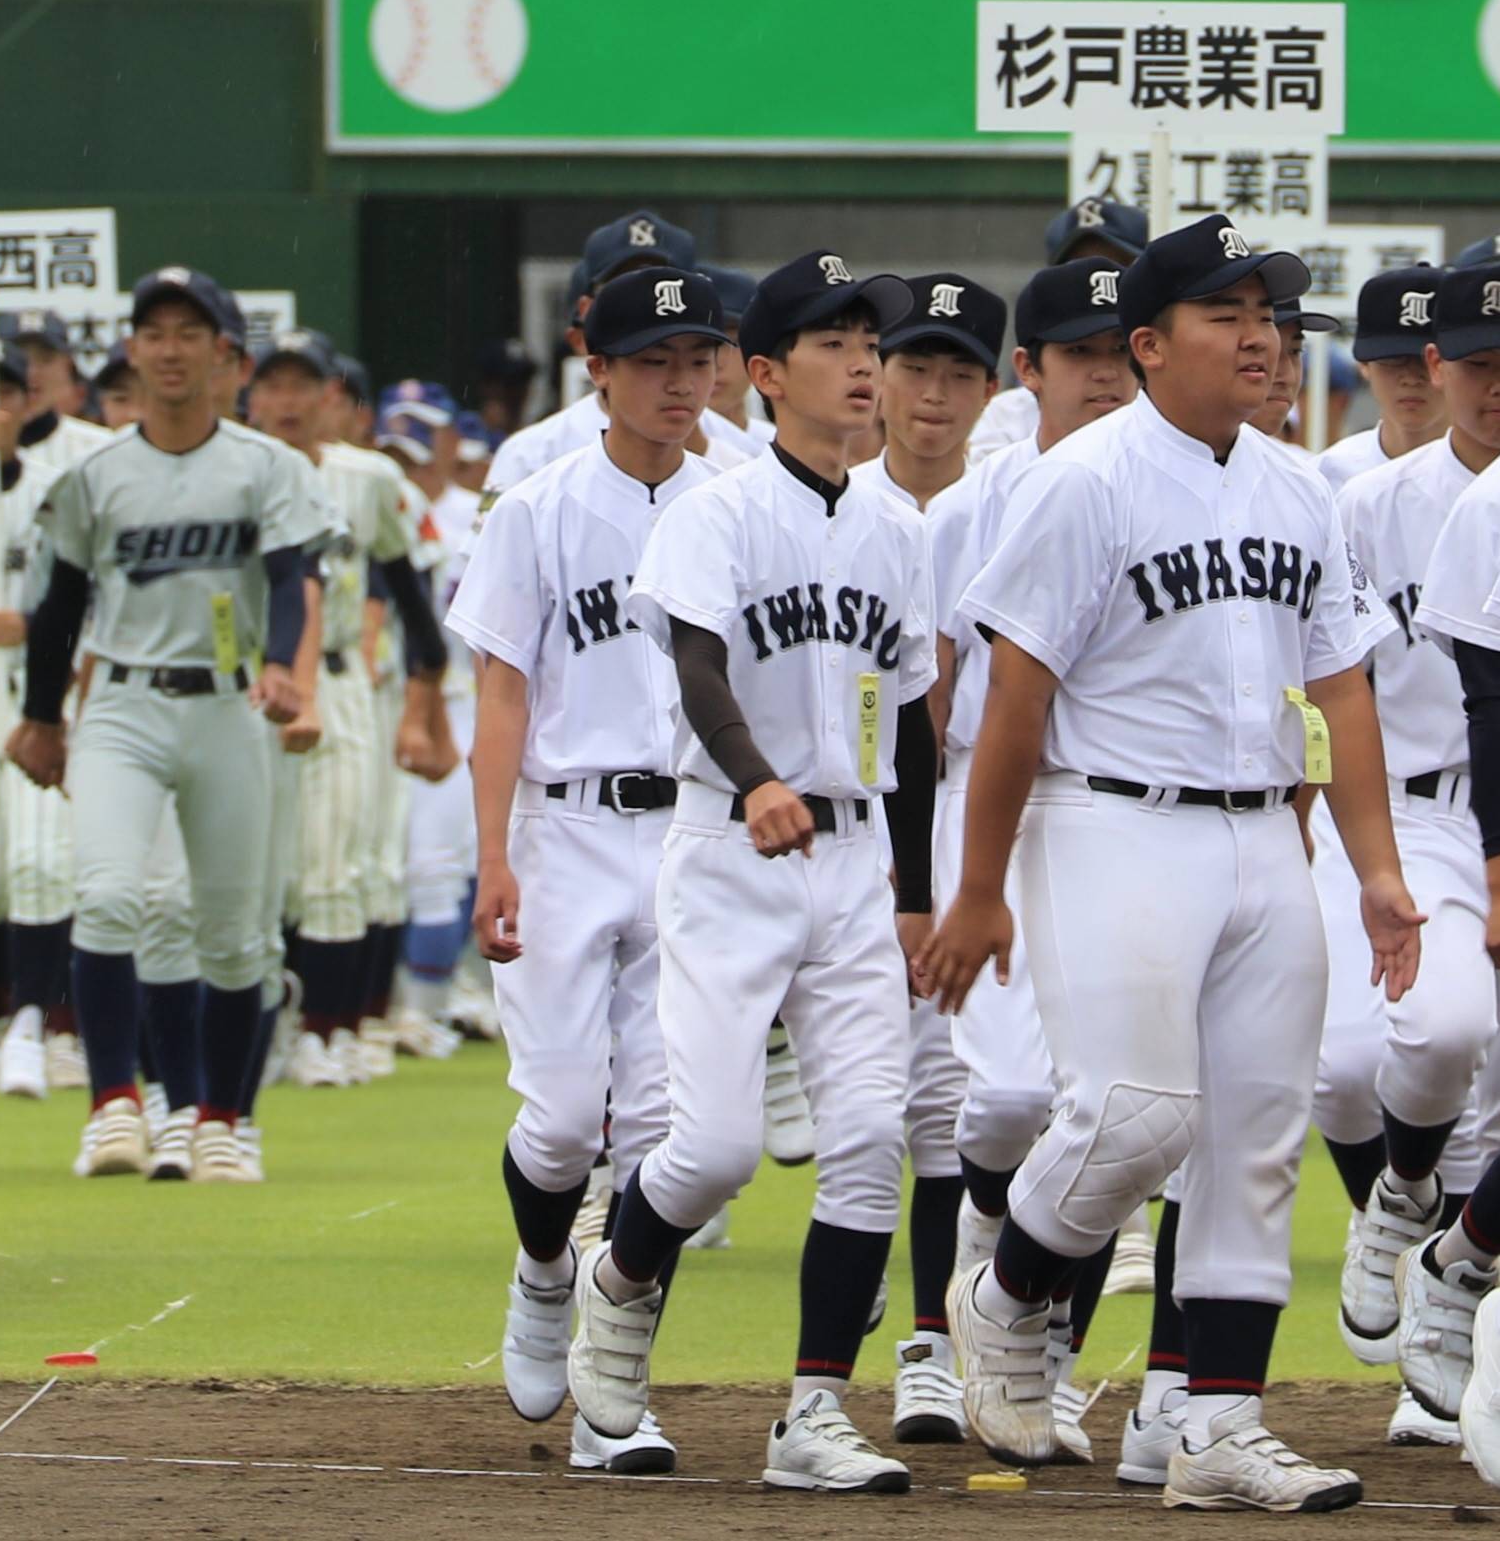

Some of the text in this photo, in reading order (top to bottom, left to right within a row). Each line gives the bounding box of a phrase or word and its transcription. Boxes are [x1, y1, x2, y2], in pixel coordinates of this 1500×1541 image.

[997, 24, 1326, 111] 杉戸農業高
[1126, 536, 1322, 624] IWASHO
